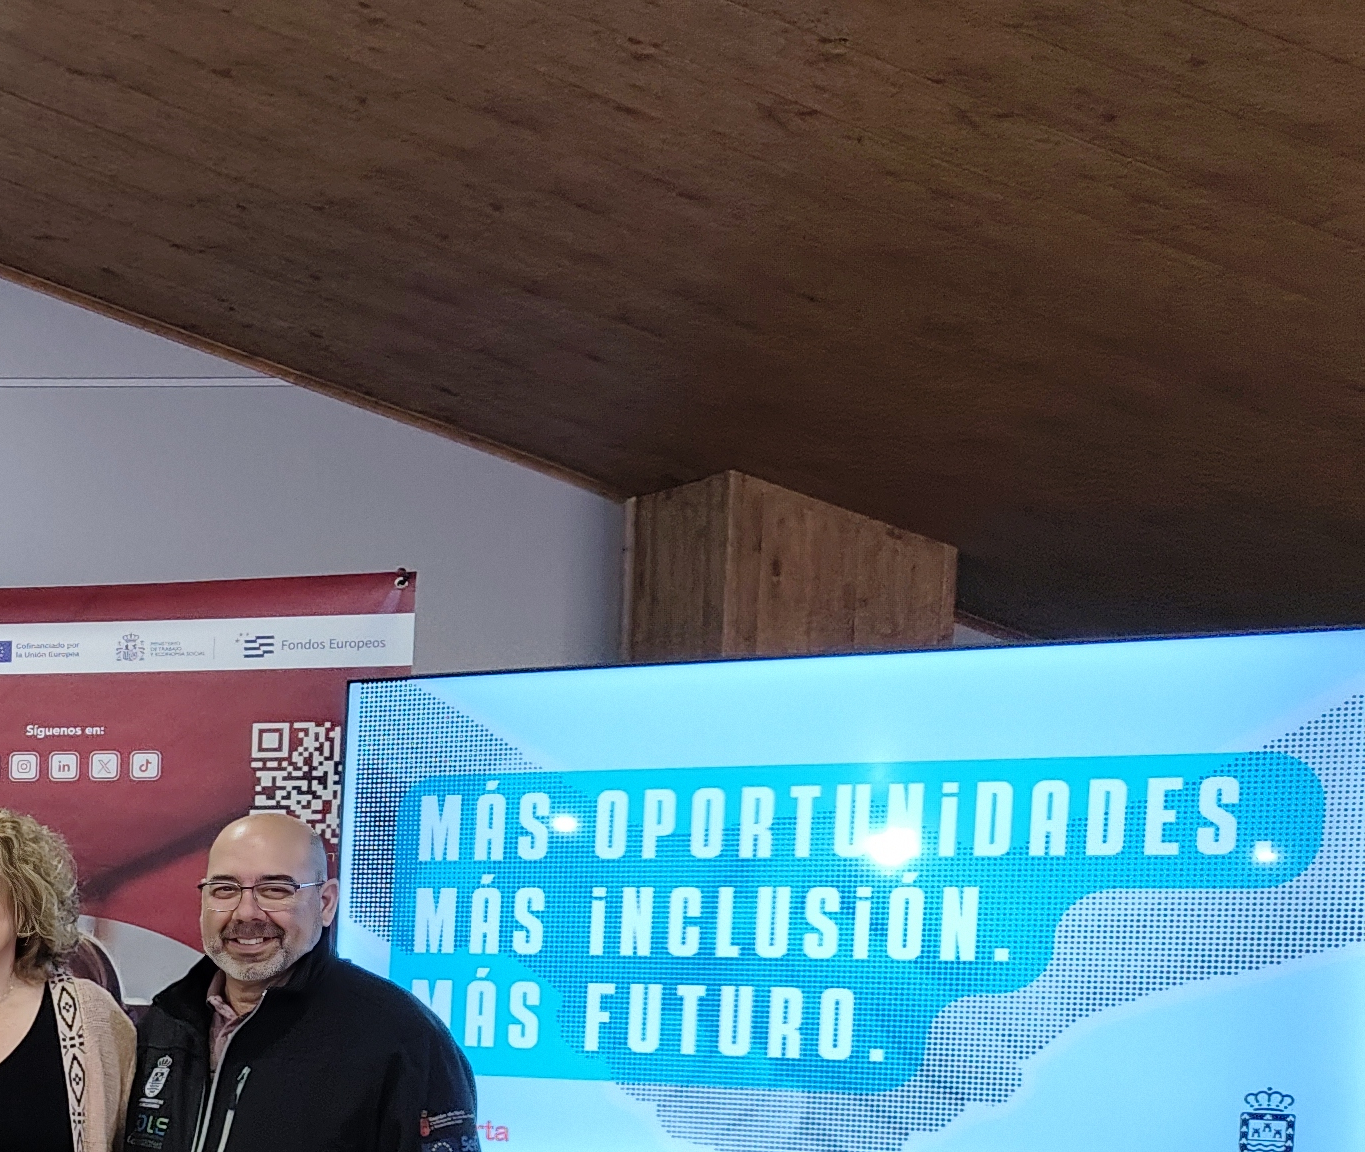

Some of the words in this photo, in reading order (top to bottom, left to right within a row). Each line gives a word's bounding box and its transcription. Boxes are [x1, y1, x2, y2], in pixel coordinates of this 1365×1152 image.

[15, 642, 65, 650] Cofinanciado
[280, 639, 326, 651] Fondos
[329, 638, 386, 652] Europeos
[25, 725, 82, 739] Síguenos
[85, 726, 105, 736] en:
[418, 780, 551, 861] MÁS
[413, 874, 546, 955] MÁS
[410, 967, 542, 1050] MÁS
[584, 982, 885, 1063] FUTURO.
